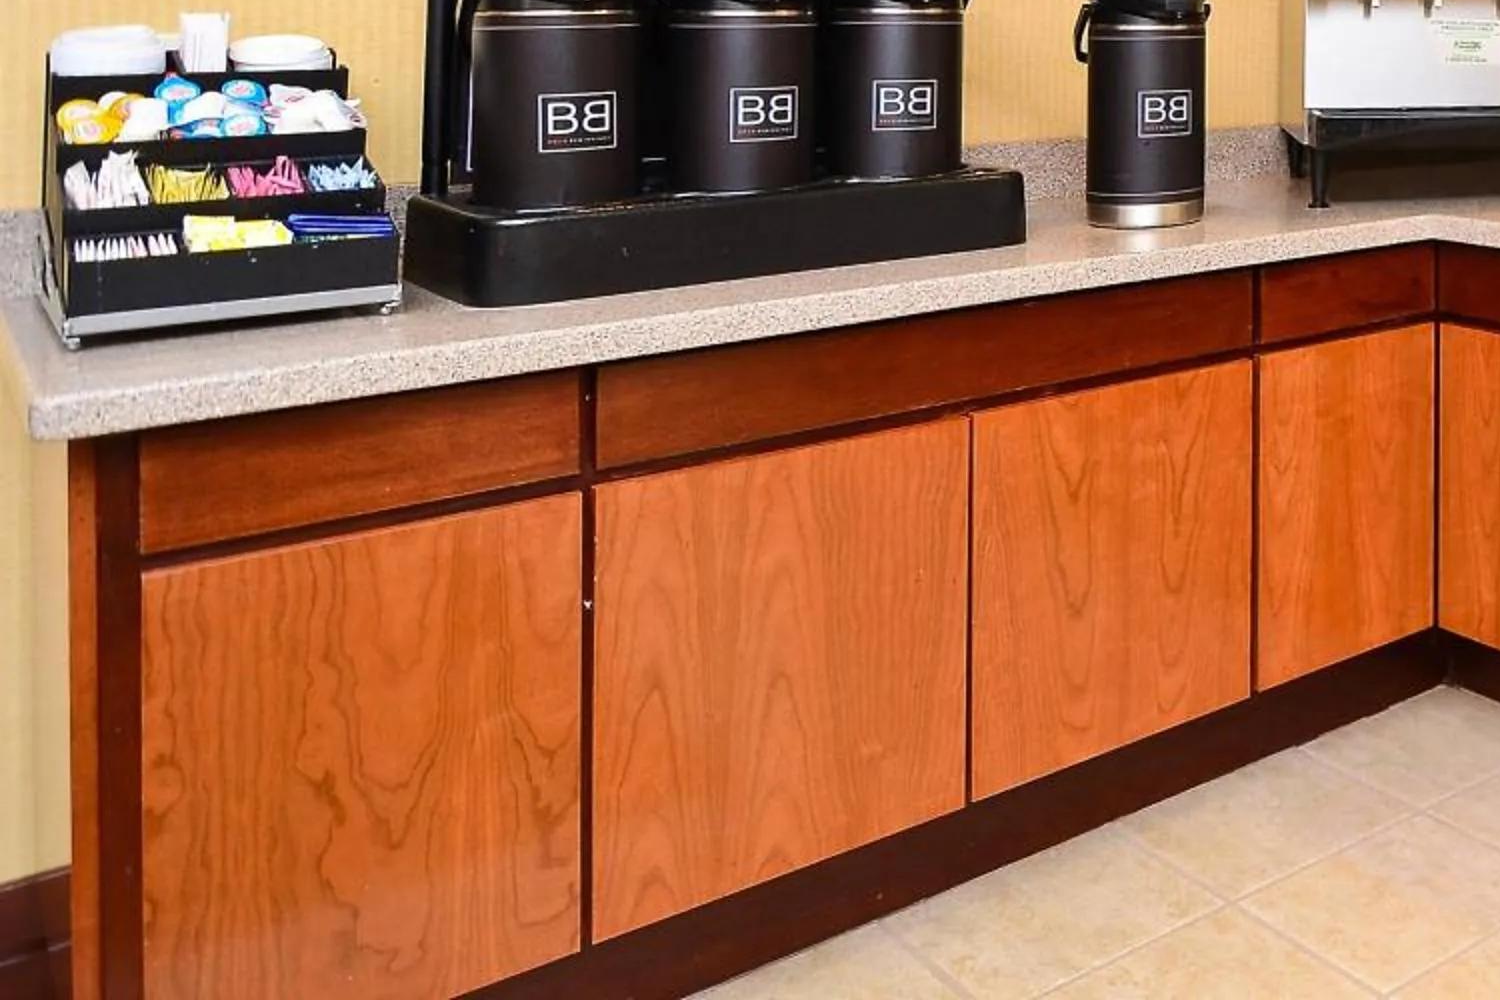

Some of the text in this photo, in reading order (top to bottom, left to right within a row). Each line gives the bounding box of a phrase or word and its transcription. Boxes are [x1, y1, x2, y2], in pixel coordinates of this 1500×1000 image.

[738, 93, 792, 126] BB
[880, 87, 931, 115] BB
[1144, 96, 1187, 123] BB
[547, 99, 610, 135] BB
